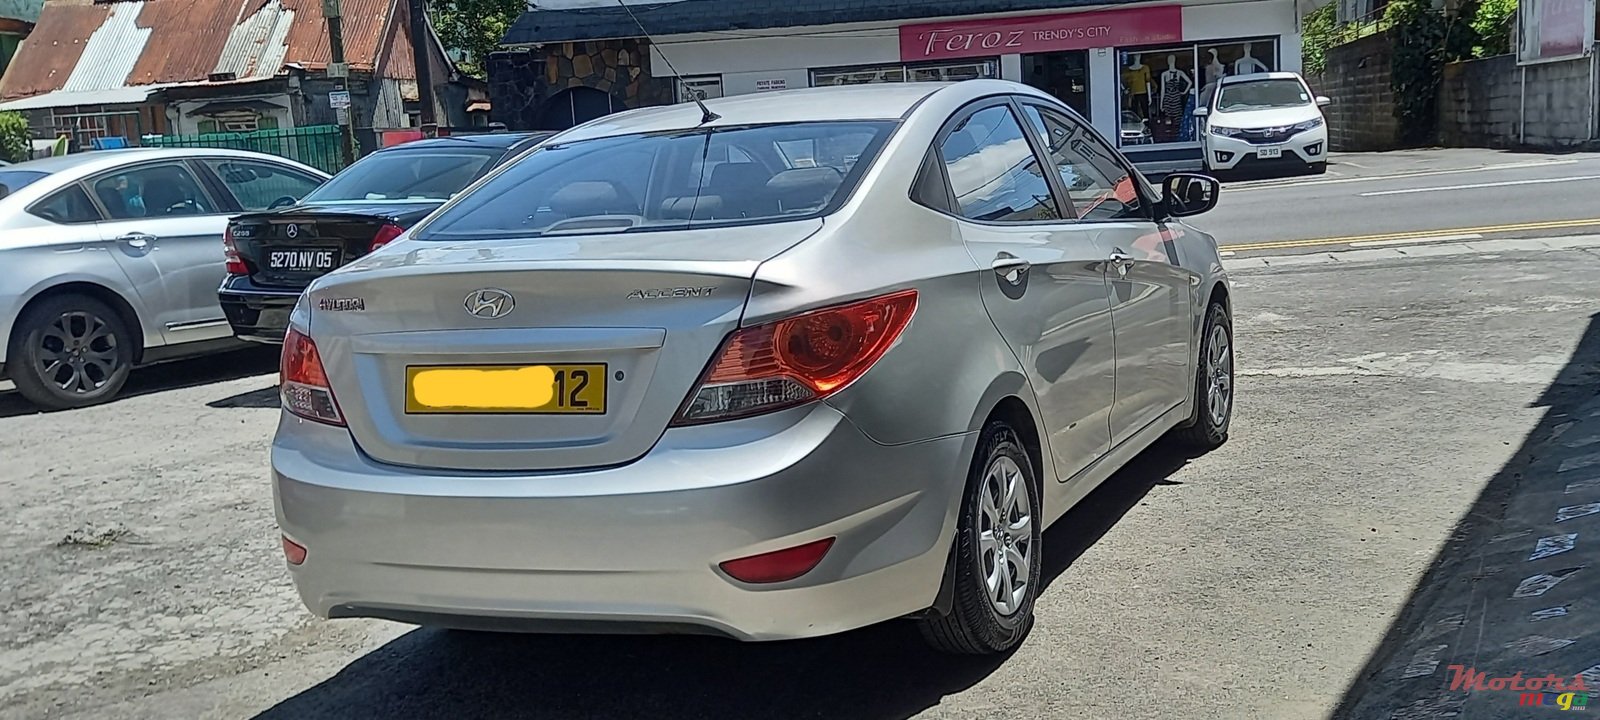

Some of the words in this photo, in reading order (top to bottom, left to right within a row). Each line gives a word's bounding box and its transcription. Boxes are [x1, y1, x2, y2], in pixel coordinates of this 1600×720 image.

[1032, 27, 1084, 41] TRENDY'S
[1086, 25, 1111, 38] CITY
[918, 28, 1024, 55] Feroz
[270, 251, 297, 268] 5270
[299, 251, 315, 268] NV
[316, 251, 332, 268] 05
[626, 286, 717, 300] ACCENT
[319, 298, 365, 311] HYUNDAI
[554, 370, 589, 407] 12
